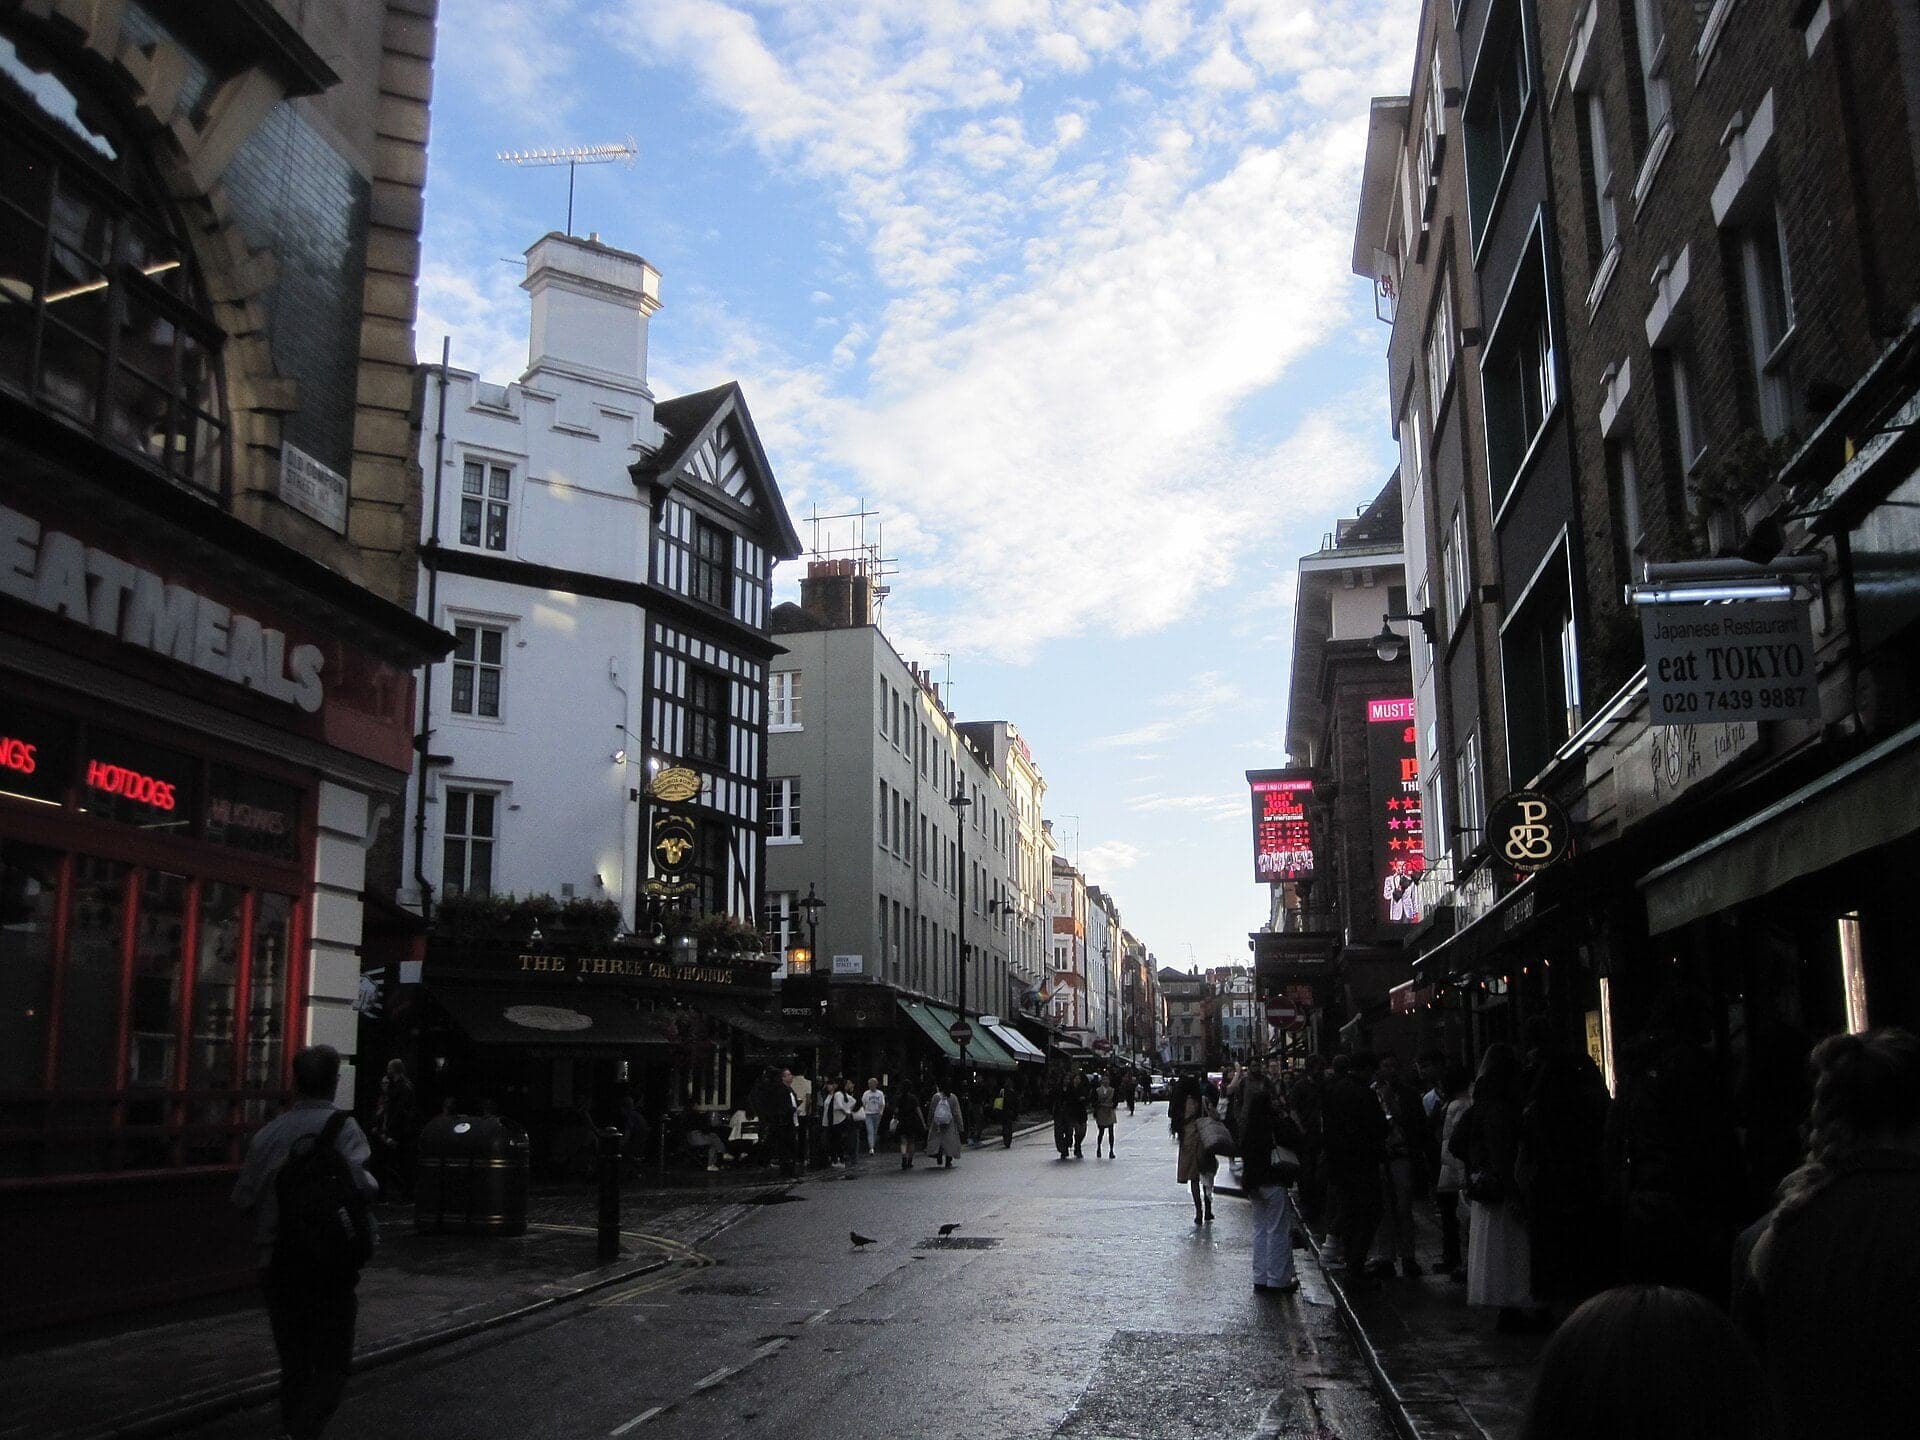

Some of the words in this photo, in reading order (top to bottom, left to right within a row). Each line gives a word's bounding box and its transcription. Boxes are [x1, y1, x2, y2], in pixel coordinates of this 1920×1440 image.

[286, 468, 316, 497] STREET
[1654, 622, 1719, 642] Japanese
[1723, 617, 1799, 636] Restaurant
[1658, 650, 1697, 683] eat
[1706, 643, 1804, 681] TOKYO
[1372, 703, 1404, 719] MUST
[1662, 692, 1698, 713] 020
[1705, 690, 1753, 711] 7439
[1760, 687, 1808, 708] 9887
[86, 759, 176, 811] HOTDOGS
[1265, 791, 1293, 801] ain't
[1263, 803, 1302, 816] proud
[519, 954, 566, 972] THE
[577, 957, 643, 976] THREE
[649, 961, 734, 984] GREYHOUNDS
